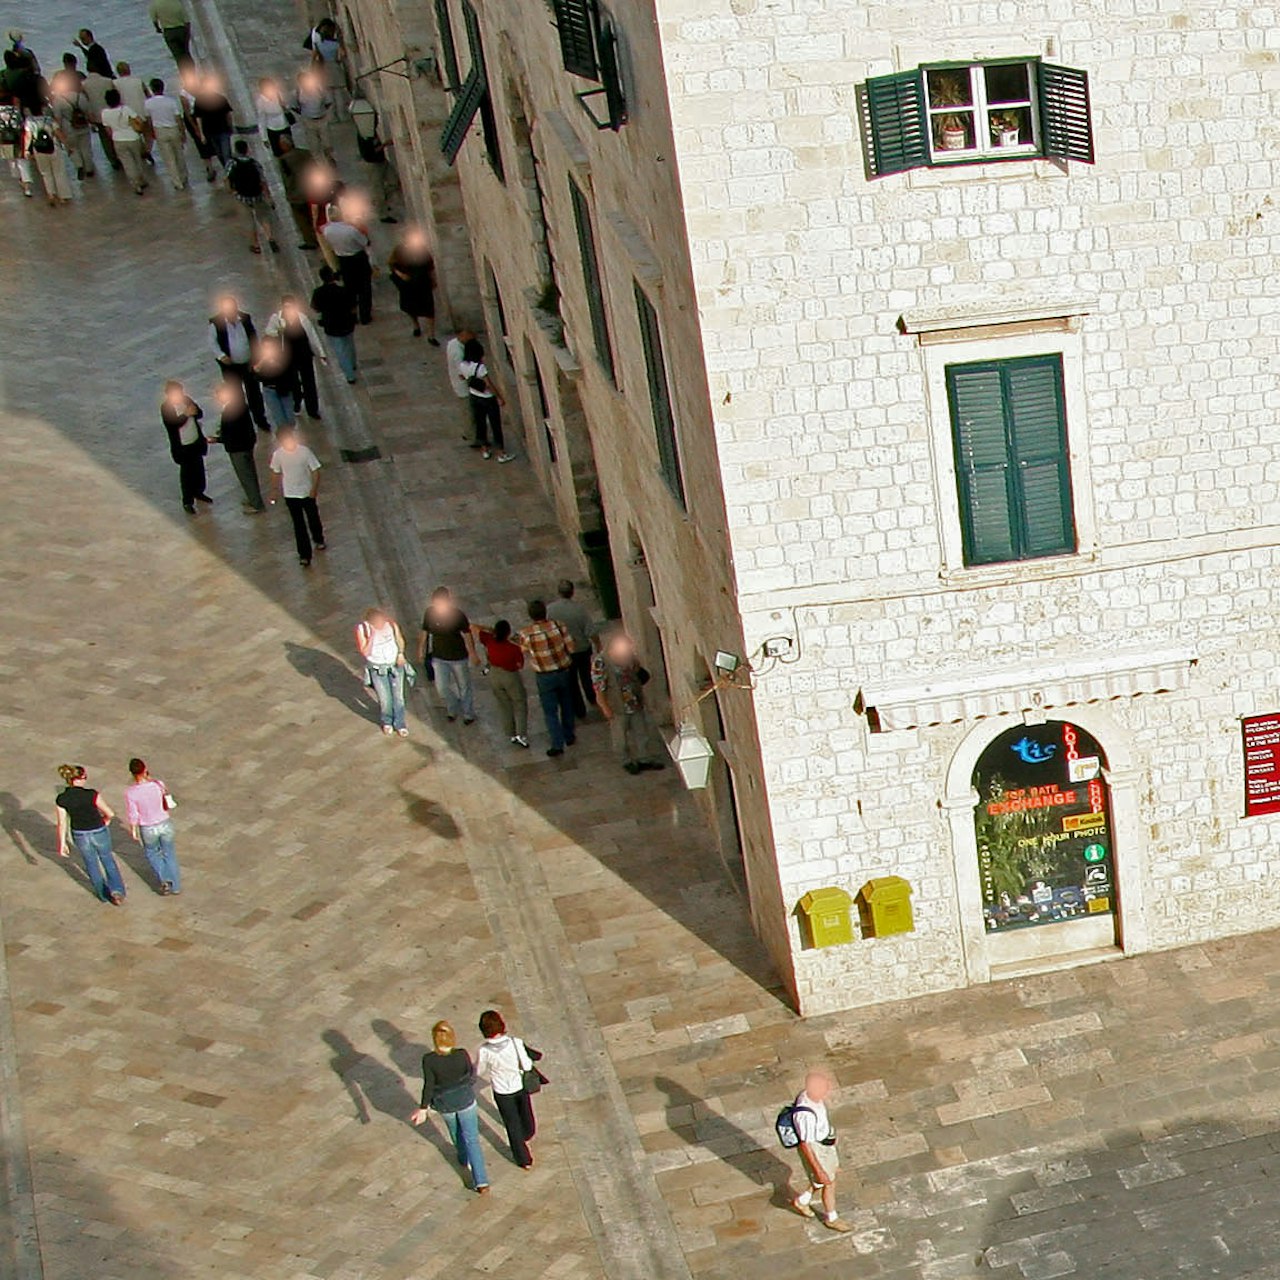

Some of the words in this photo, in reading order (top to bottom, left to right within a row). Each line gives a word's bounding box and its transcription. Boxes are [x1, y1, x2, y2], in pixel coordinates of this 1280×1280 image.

[988, 790, 1077, 815] EXCHANGE
[1018, 837, 1039, 848] ONE
[1074, 826, 1107, 839] PHOTO
